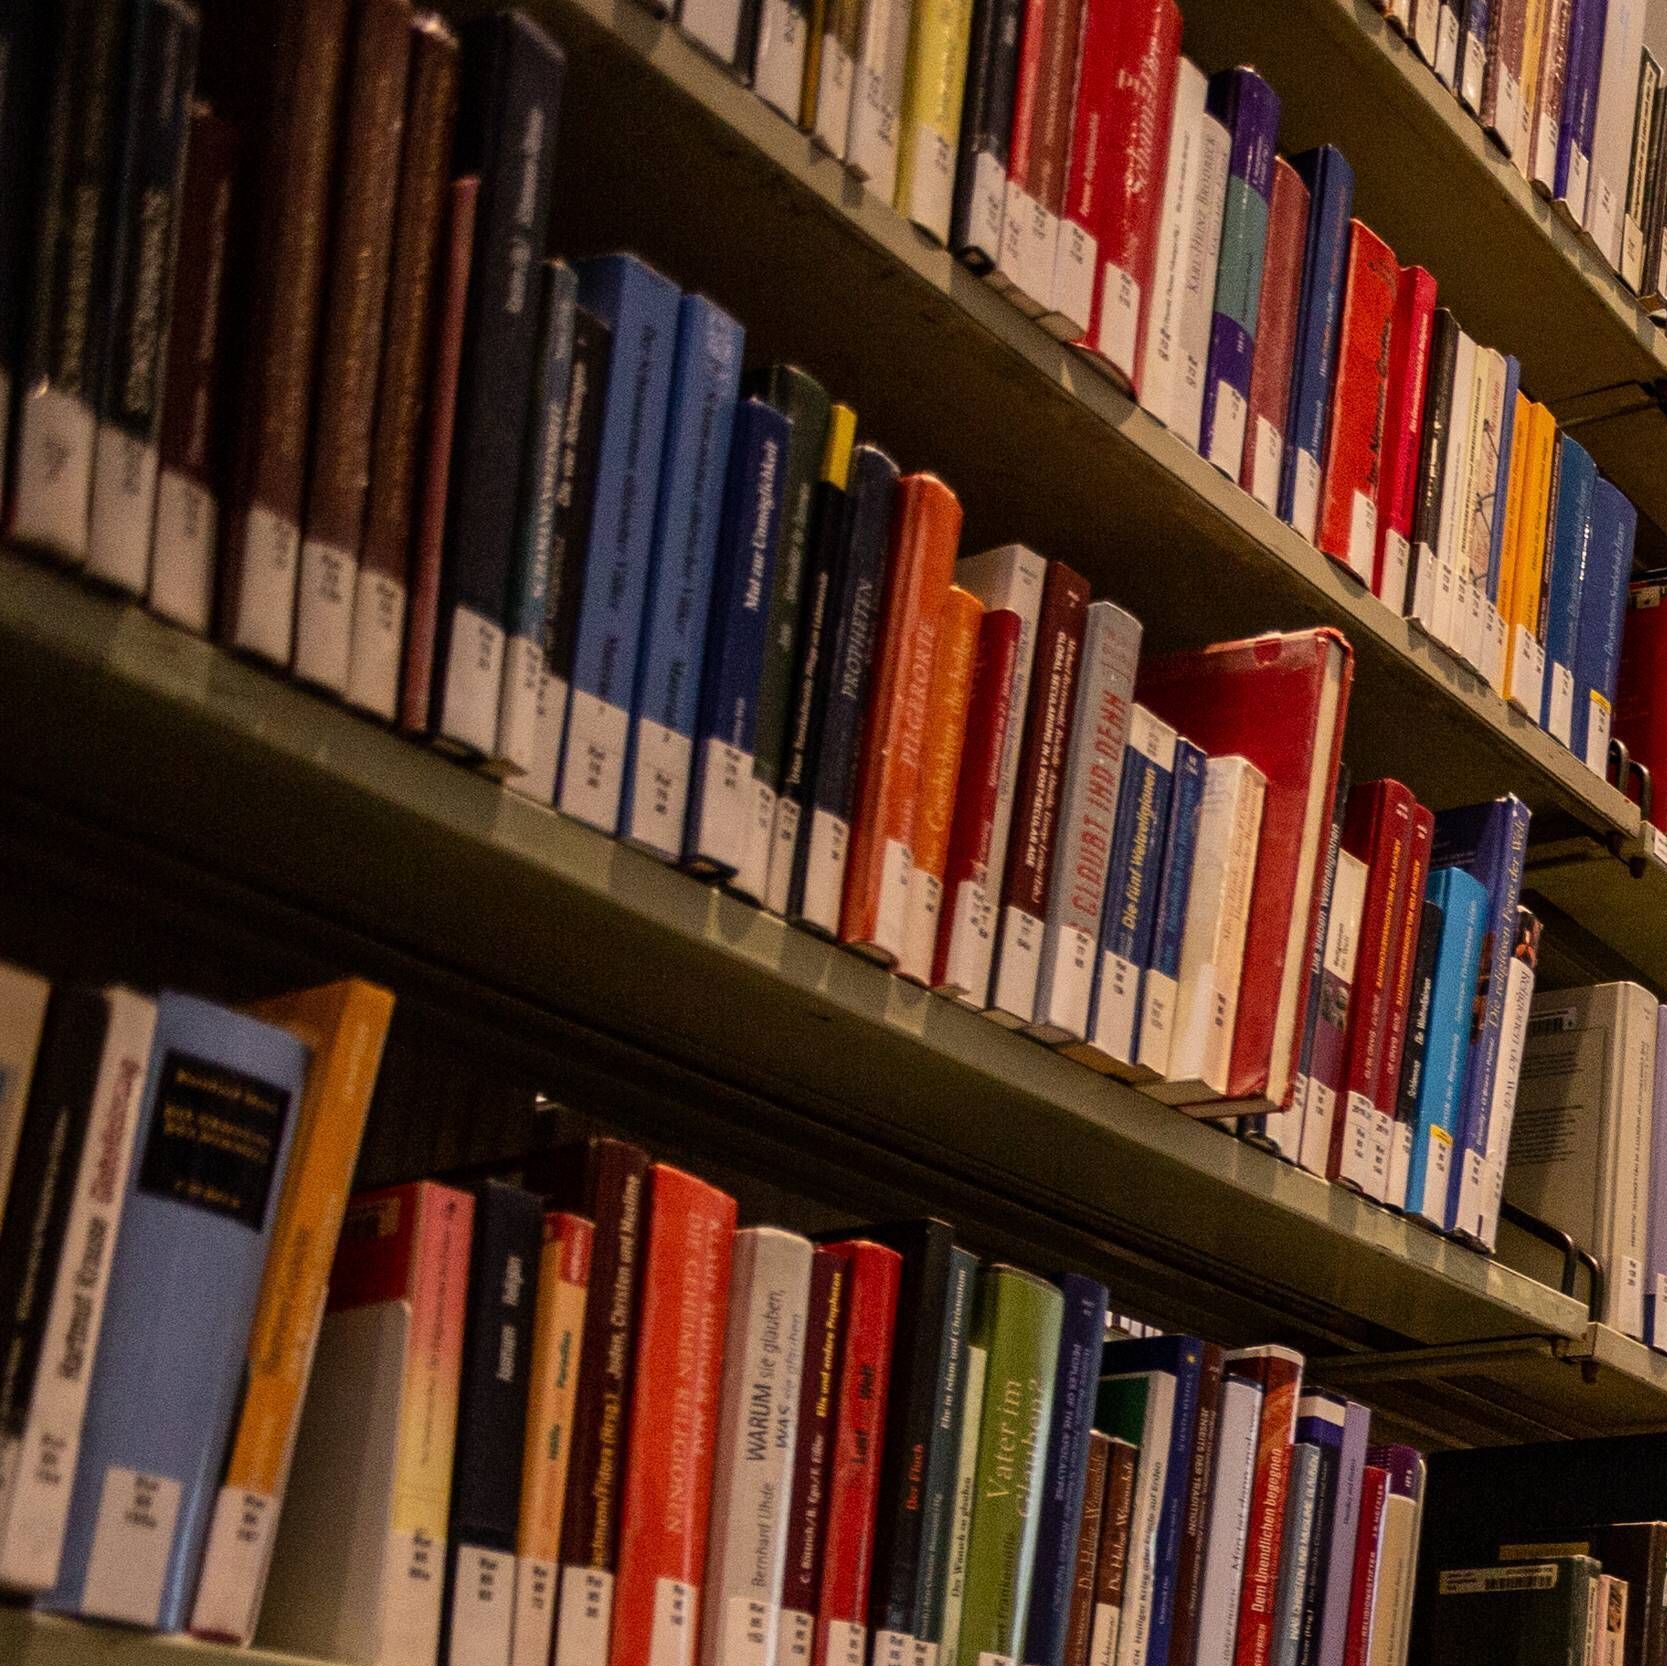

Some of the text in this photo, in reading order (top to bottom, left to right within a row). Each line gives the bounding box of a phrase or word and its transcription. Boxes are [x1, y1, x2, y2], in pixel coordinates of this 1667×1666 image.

[742, 439, 780, 611] Mut zur Unmöglichkeit
[837, 574, 877, 699] PROPHETEN
[1050, 631, 1067, 671] GLOBAL
[1041, 672, 1061, 743] SECULARISMS
[1024, 844, 1036, 866] AGE
[1027, 765, 1047, 843] POST-SECULAR
[1119, 767, 1158, 929] Die fünf Weltreligionen
[1488, 819, 1525, 1027] Die religiösen Feste der Welt
[745, 1288, 787, 1461] WARUM sie glauben,
[773, 1313, 805, 1448] WAS sie glauben
[985, 1378, 1025, 1501] Vater im
[1186, 1407, 1209, 1536] JENSEITS DER TRADITION?
[750, 1481, 776, 1586] Bernhard Uhde
